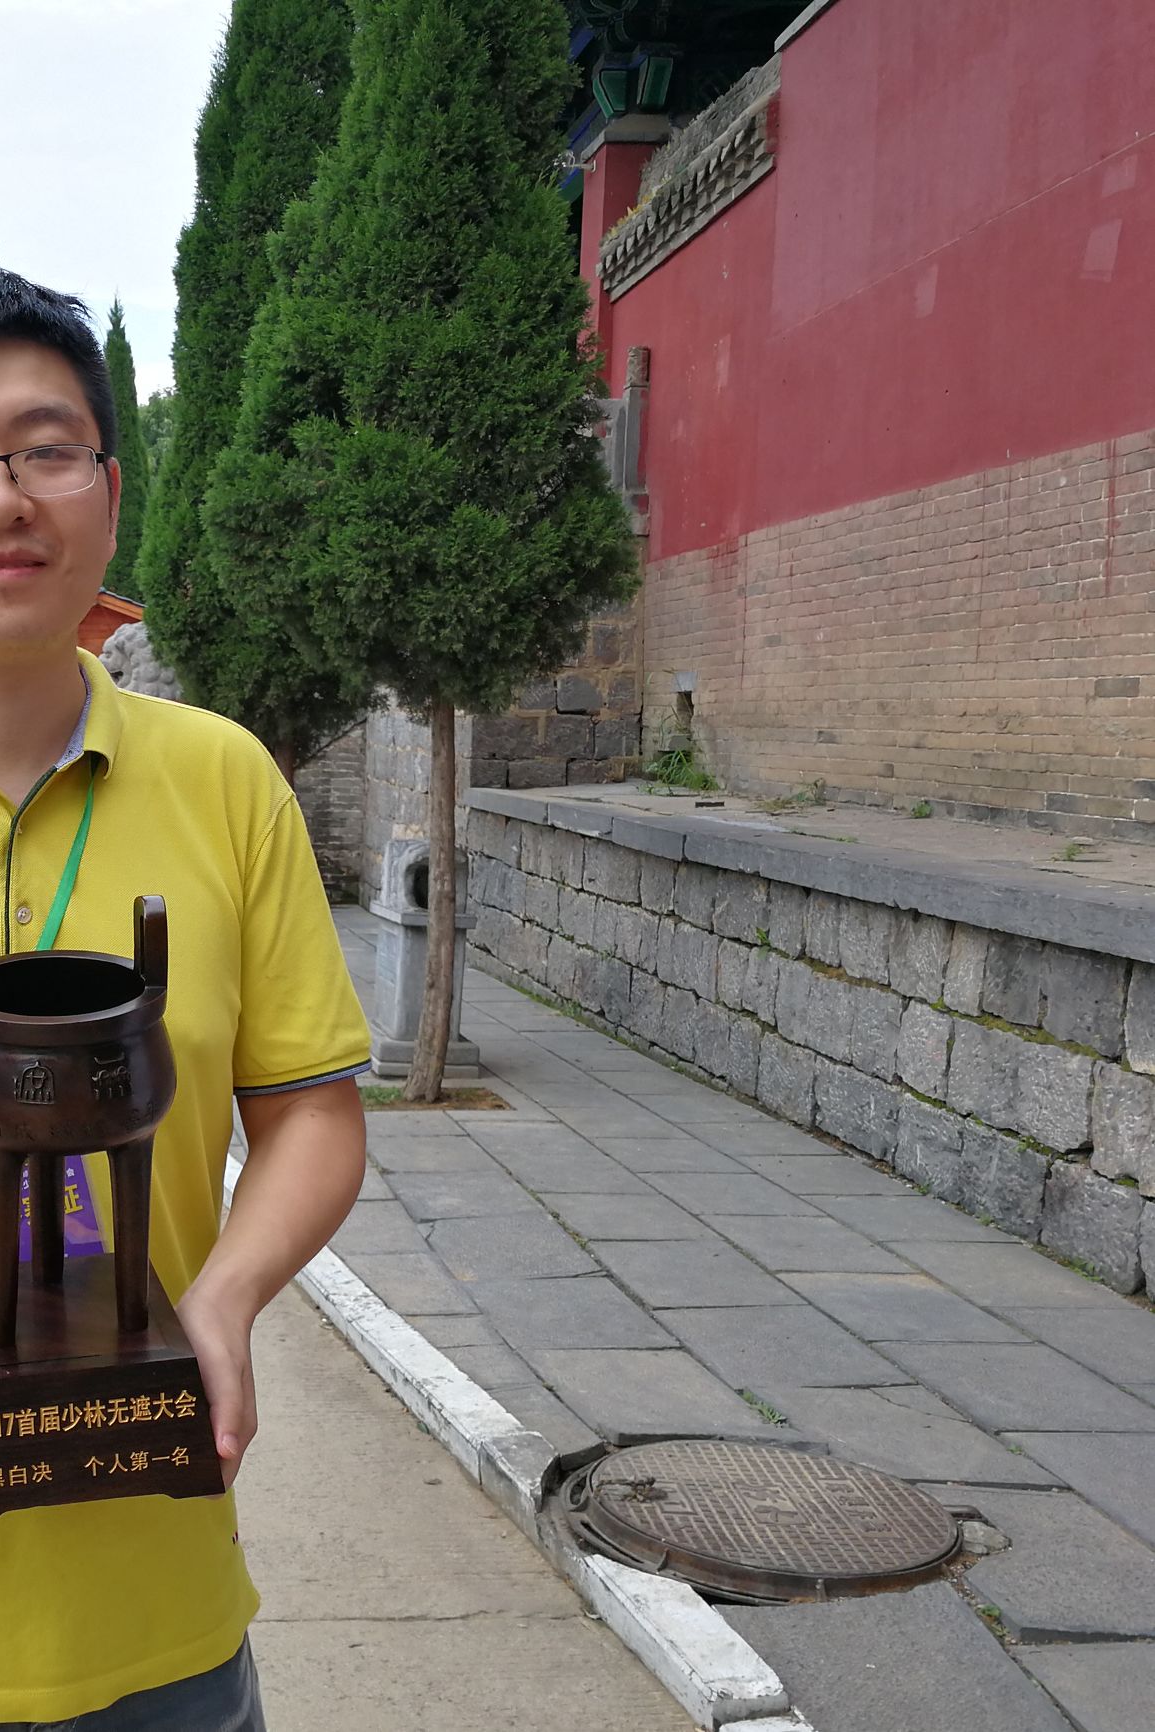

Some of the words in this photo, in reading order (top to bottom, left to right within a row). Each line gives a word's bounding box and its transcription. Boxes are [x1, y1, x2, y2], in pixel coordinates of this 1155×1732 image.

[84, 1446, 189, 1476] 个人第一名
